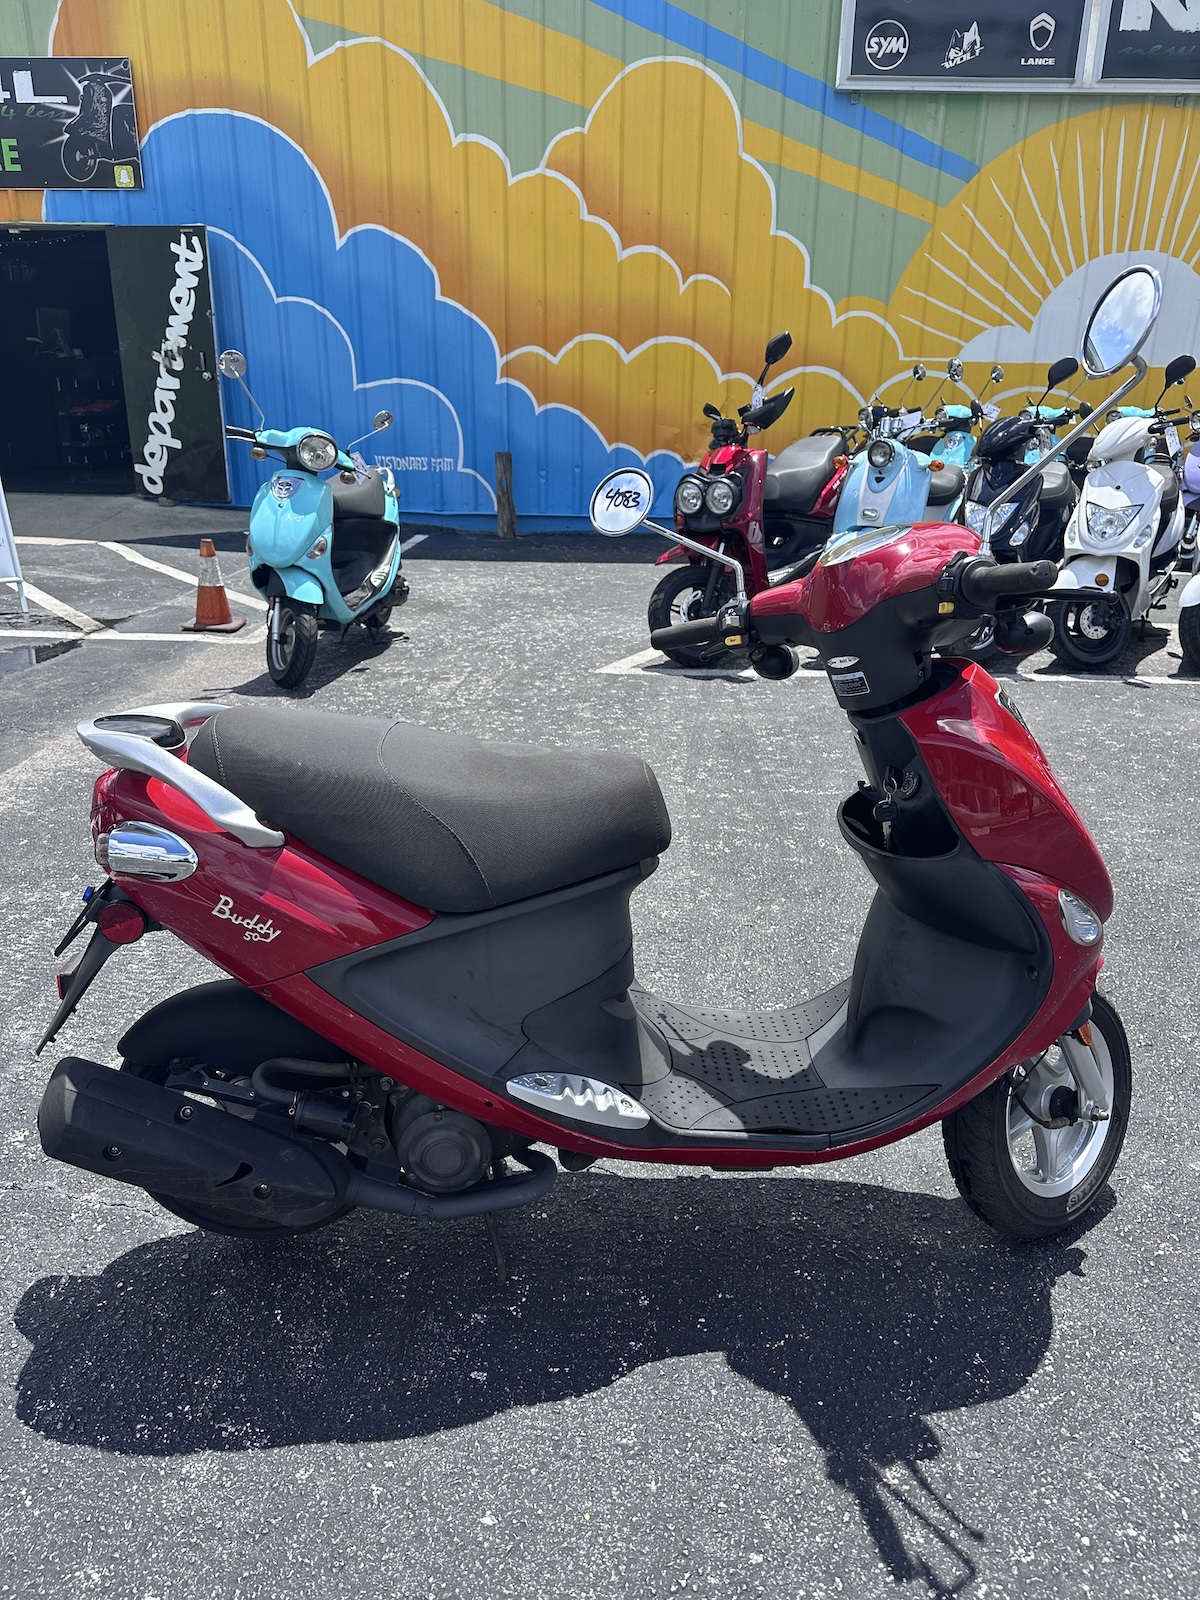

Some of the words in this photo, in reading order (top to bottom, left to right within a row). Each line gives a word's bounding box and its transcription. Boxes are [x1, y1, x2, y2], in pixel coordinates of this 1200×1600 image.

[868, 36, 906, 59] SYM
[941, 46, 985, 69] WOLF
[1020, 57, 1056, 66] LANCE
[25, 104, 68, 118] less
[0, 138, 22, 172] E
[374, 455, 428, 472] VISIONARY
[431, 457, 454, 472] FAM
[605, 488, 641, 511] 4083
[211, 894, 282, 943] Buddy
[243, 931, 260, 942] 50
